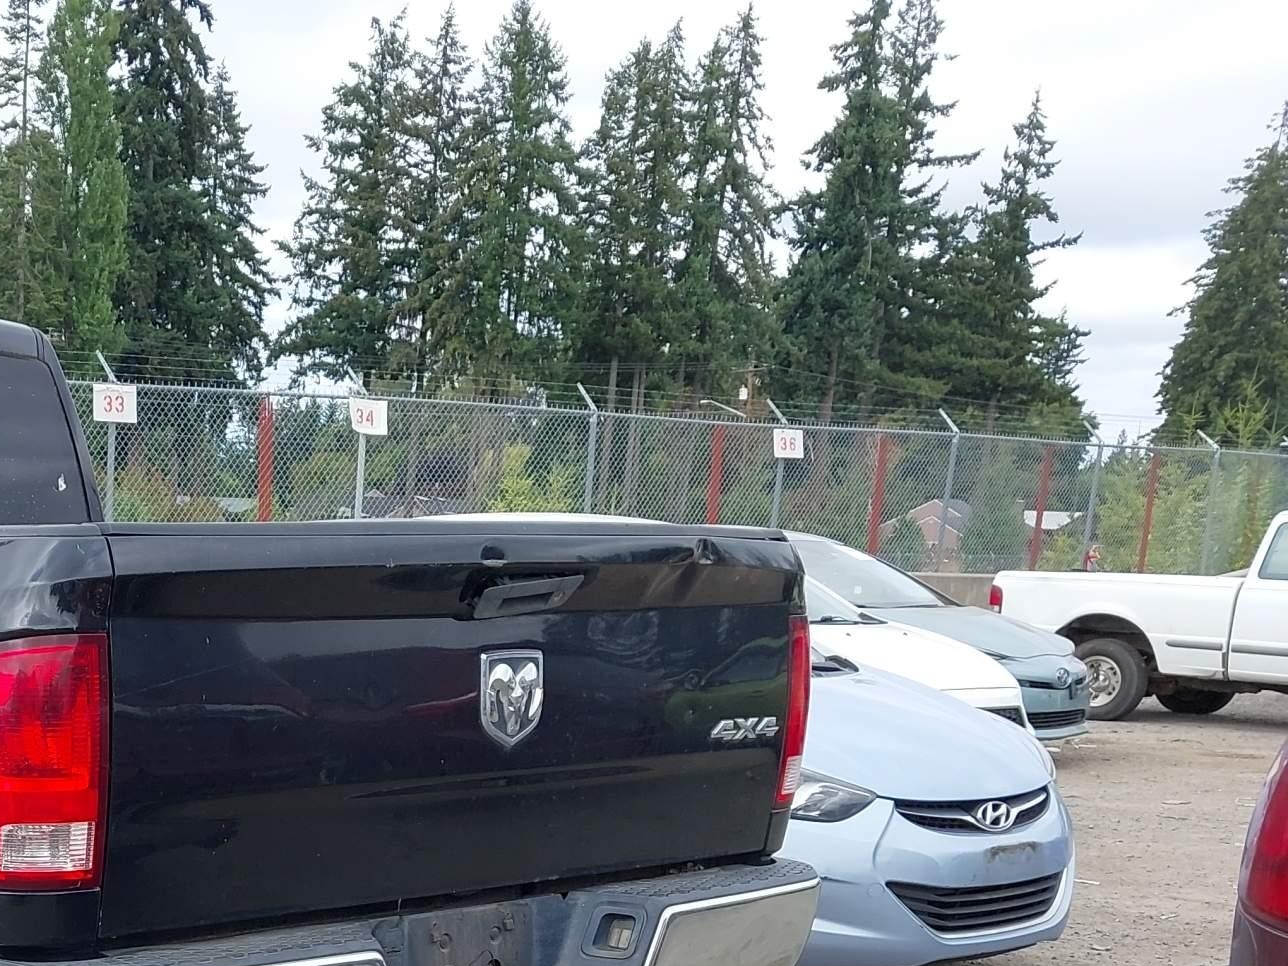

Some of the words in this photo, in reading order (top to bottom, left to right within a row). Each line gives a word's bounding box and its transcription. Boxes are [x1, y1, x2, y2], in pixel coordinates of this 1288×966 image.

[103, 395, 125, 413] 33
[355, 407, 375, 427] 34
[780, 436, 797, 452] 36
